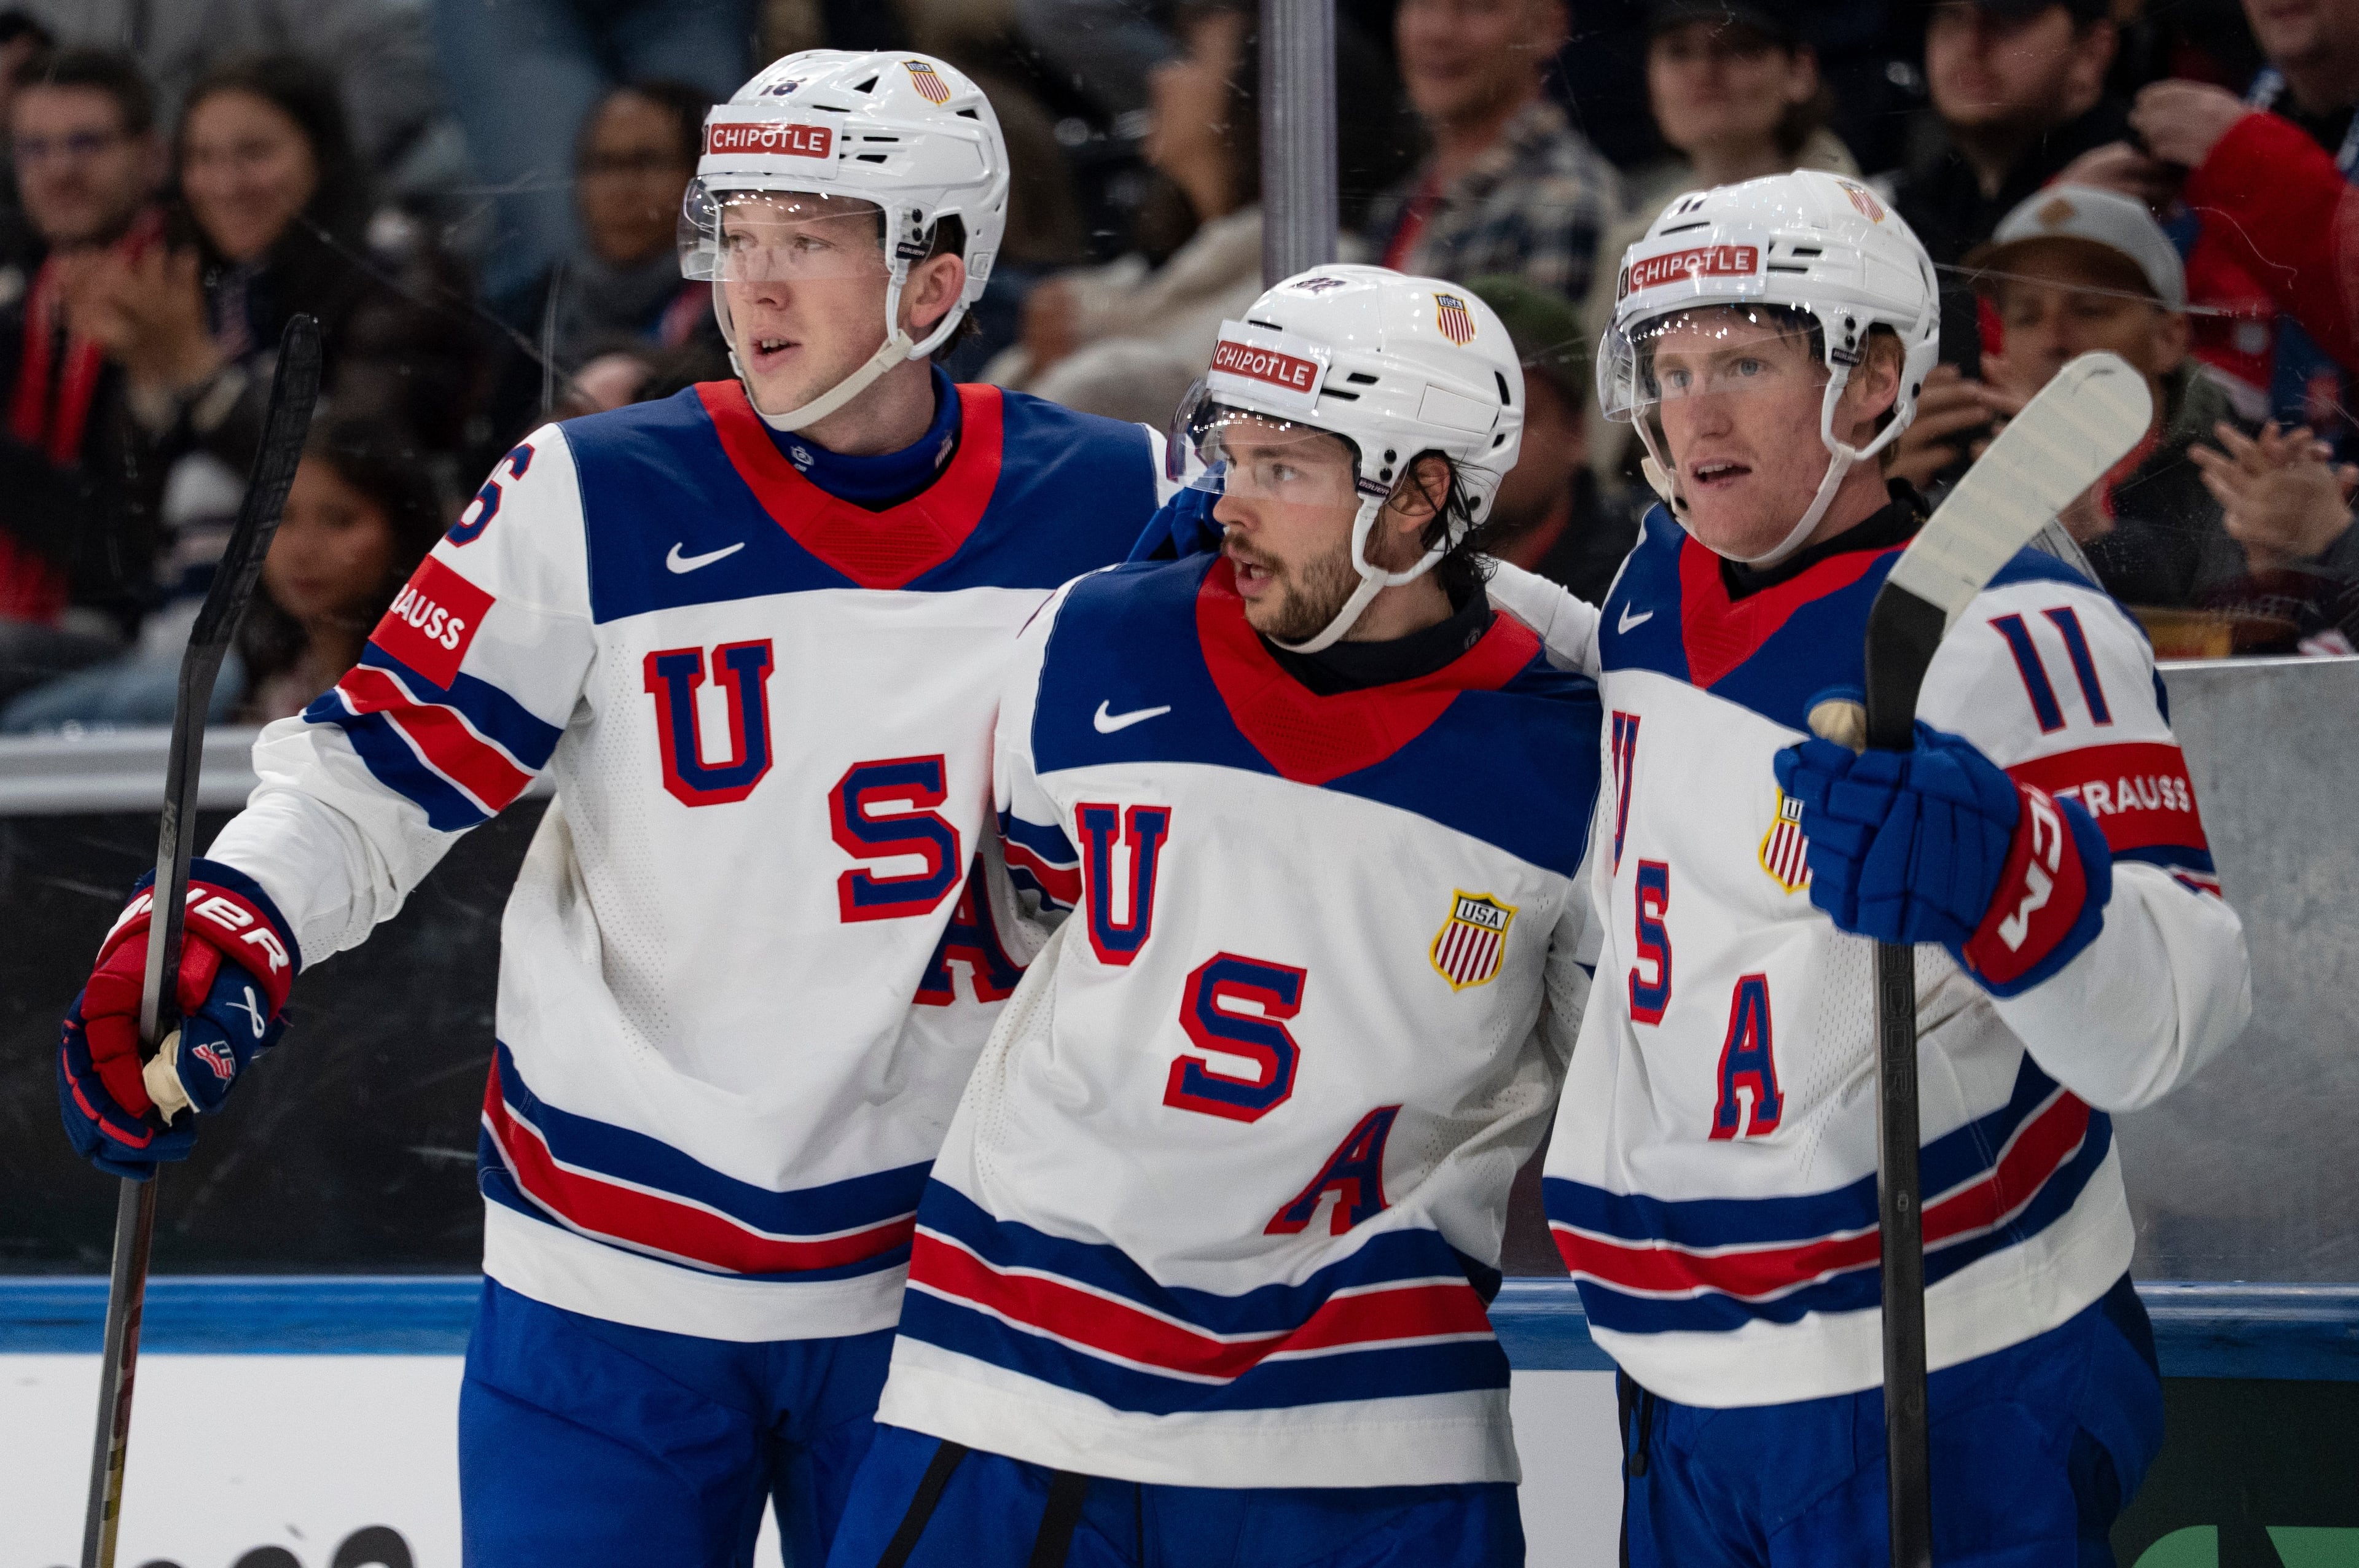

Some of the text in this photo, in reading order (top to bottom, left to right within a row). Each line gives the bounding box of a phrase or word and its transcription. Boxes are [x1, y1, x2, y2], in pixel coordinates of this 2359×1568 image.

[711, 129, 824, 152] CHIPOTLE
[898, 246, 926, 257] BAUER
[1632, 249, 1751, 286] CHIPOTLE
[1441, 298, 1461, 308] USA
[1216, 345, 1310, 386] CHIPOTLE
[1986, 606, 2114, 736] 11
[1461, 901, 1500, 928] USA
